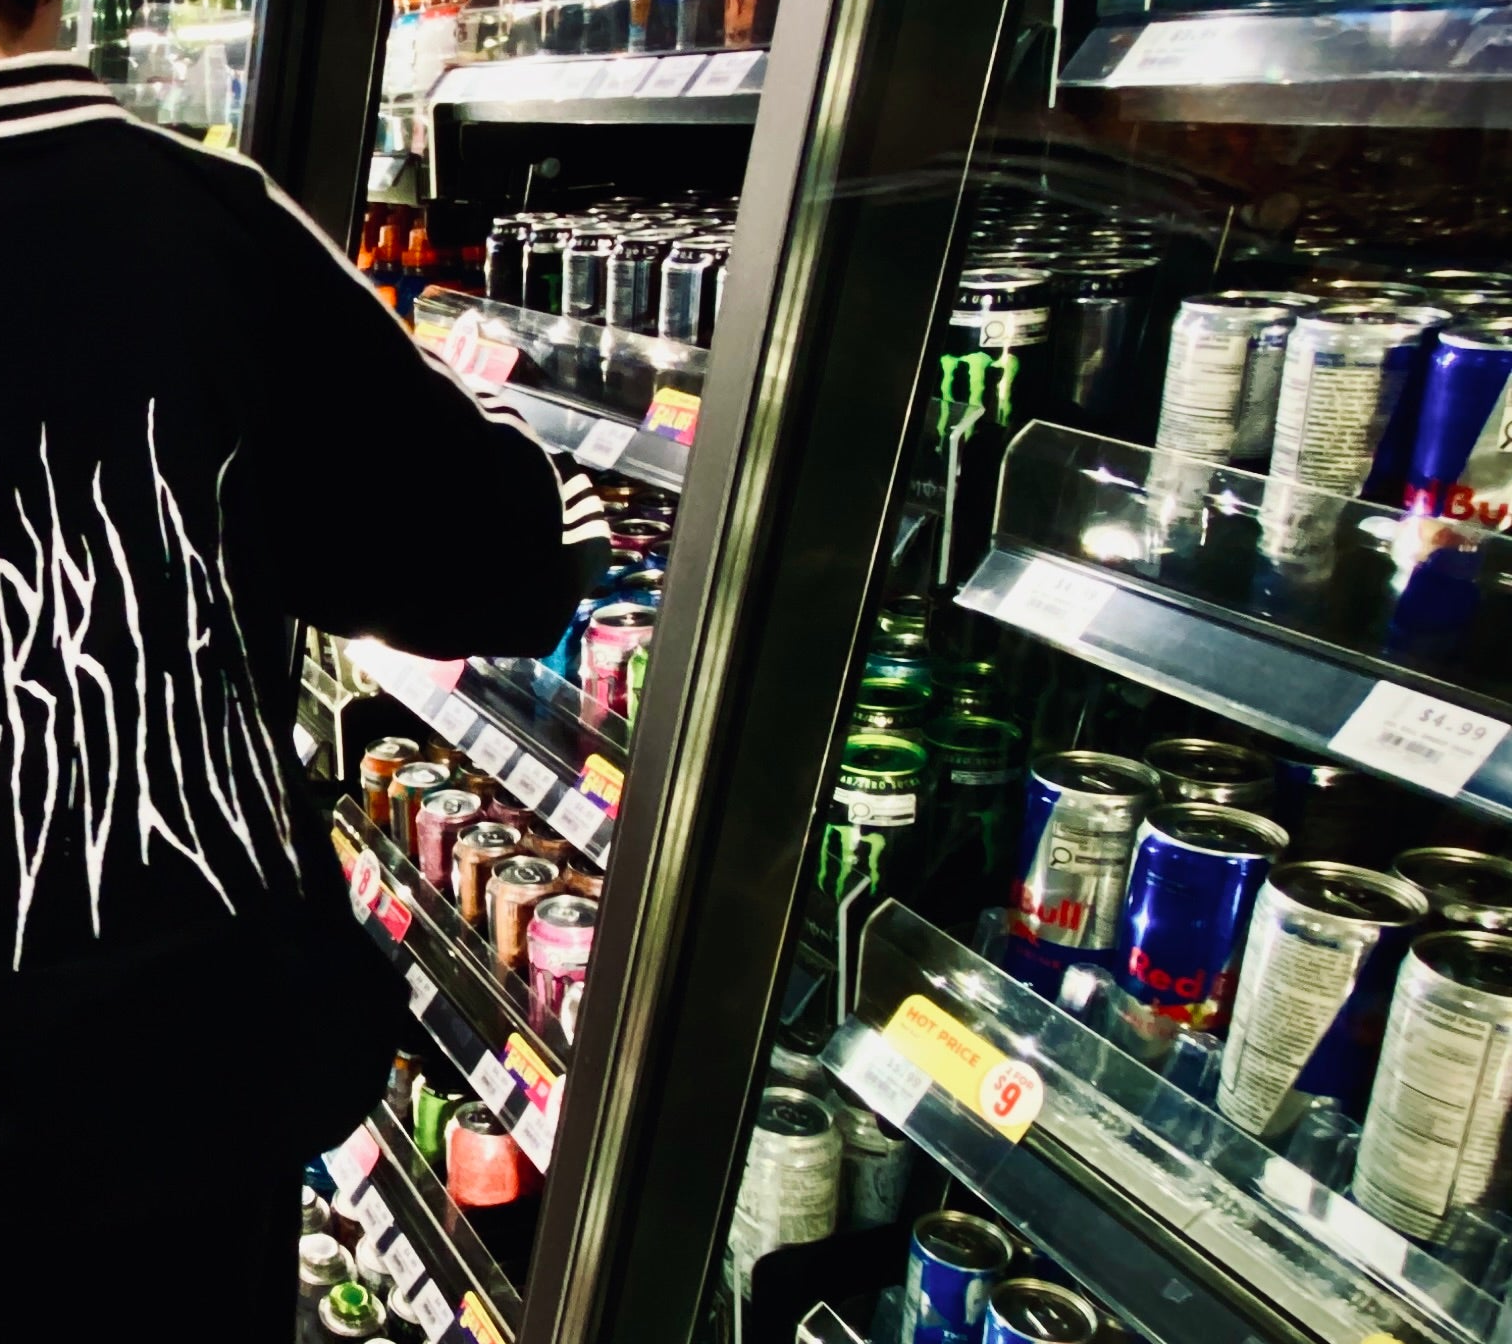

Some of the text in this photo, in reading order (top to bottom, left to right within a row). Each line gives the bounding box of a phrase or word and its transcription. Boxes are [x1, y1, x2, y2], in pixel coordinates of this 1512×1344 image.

[1418, 708, 1487, 741] $4.99
[1128, 945, 1207, 1000] Red
[906, 1006, 937, 1033] HOT
[936, 1029, 982, 1069] PRICE
[1014, 1070, 1035, 1091] FOR
